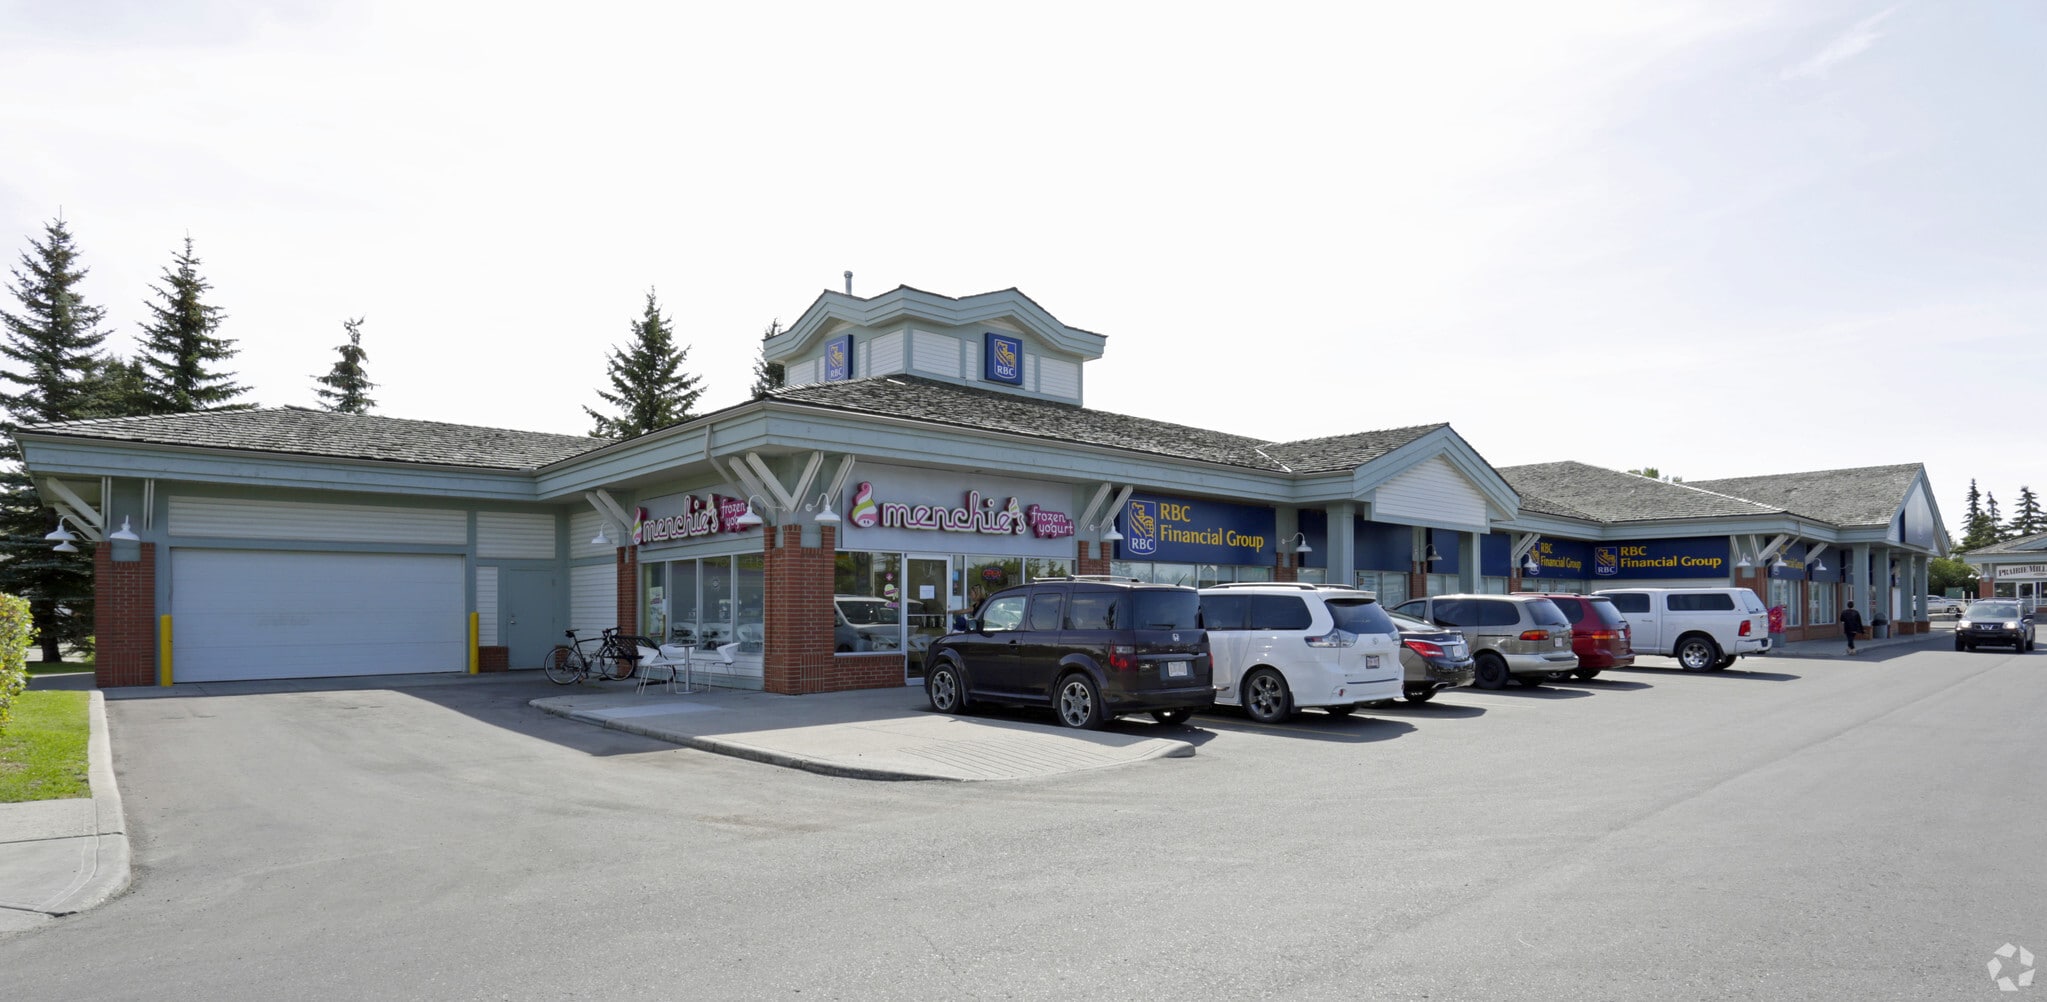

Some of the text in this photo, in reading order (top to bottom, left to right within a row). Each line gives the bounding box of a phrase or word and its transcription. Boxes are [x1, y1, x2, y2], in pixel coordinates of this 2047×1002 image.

[997, 365, 1015, 376] RBC
[643, 493, 719, 542] menchie's
[721, 499, 746, 519] frozen
[882, 490, 1026, 535] menchie's
[1031, 505, 1067, 525] frozen
[1160, 503, 1191, 522] RBC
[1038, 522, 1074, 537] yogurt
[1160, 524, 1264, 552] Financial Group
[1131, 538, 1154, 550] RBC
[1540, 542, 1553, 554] RBC
[1620, 546, 1647, 556] RBC
[1540, 555, 1582, 572] Financial Group
[1620, 555, 1722, 568] Financial Group
